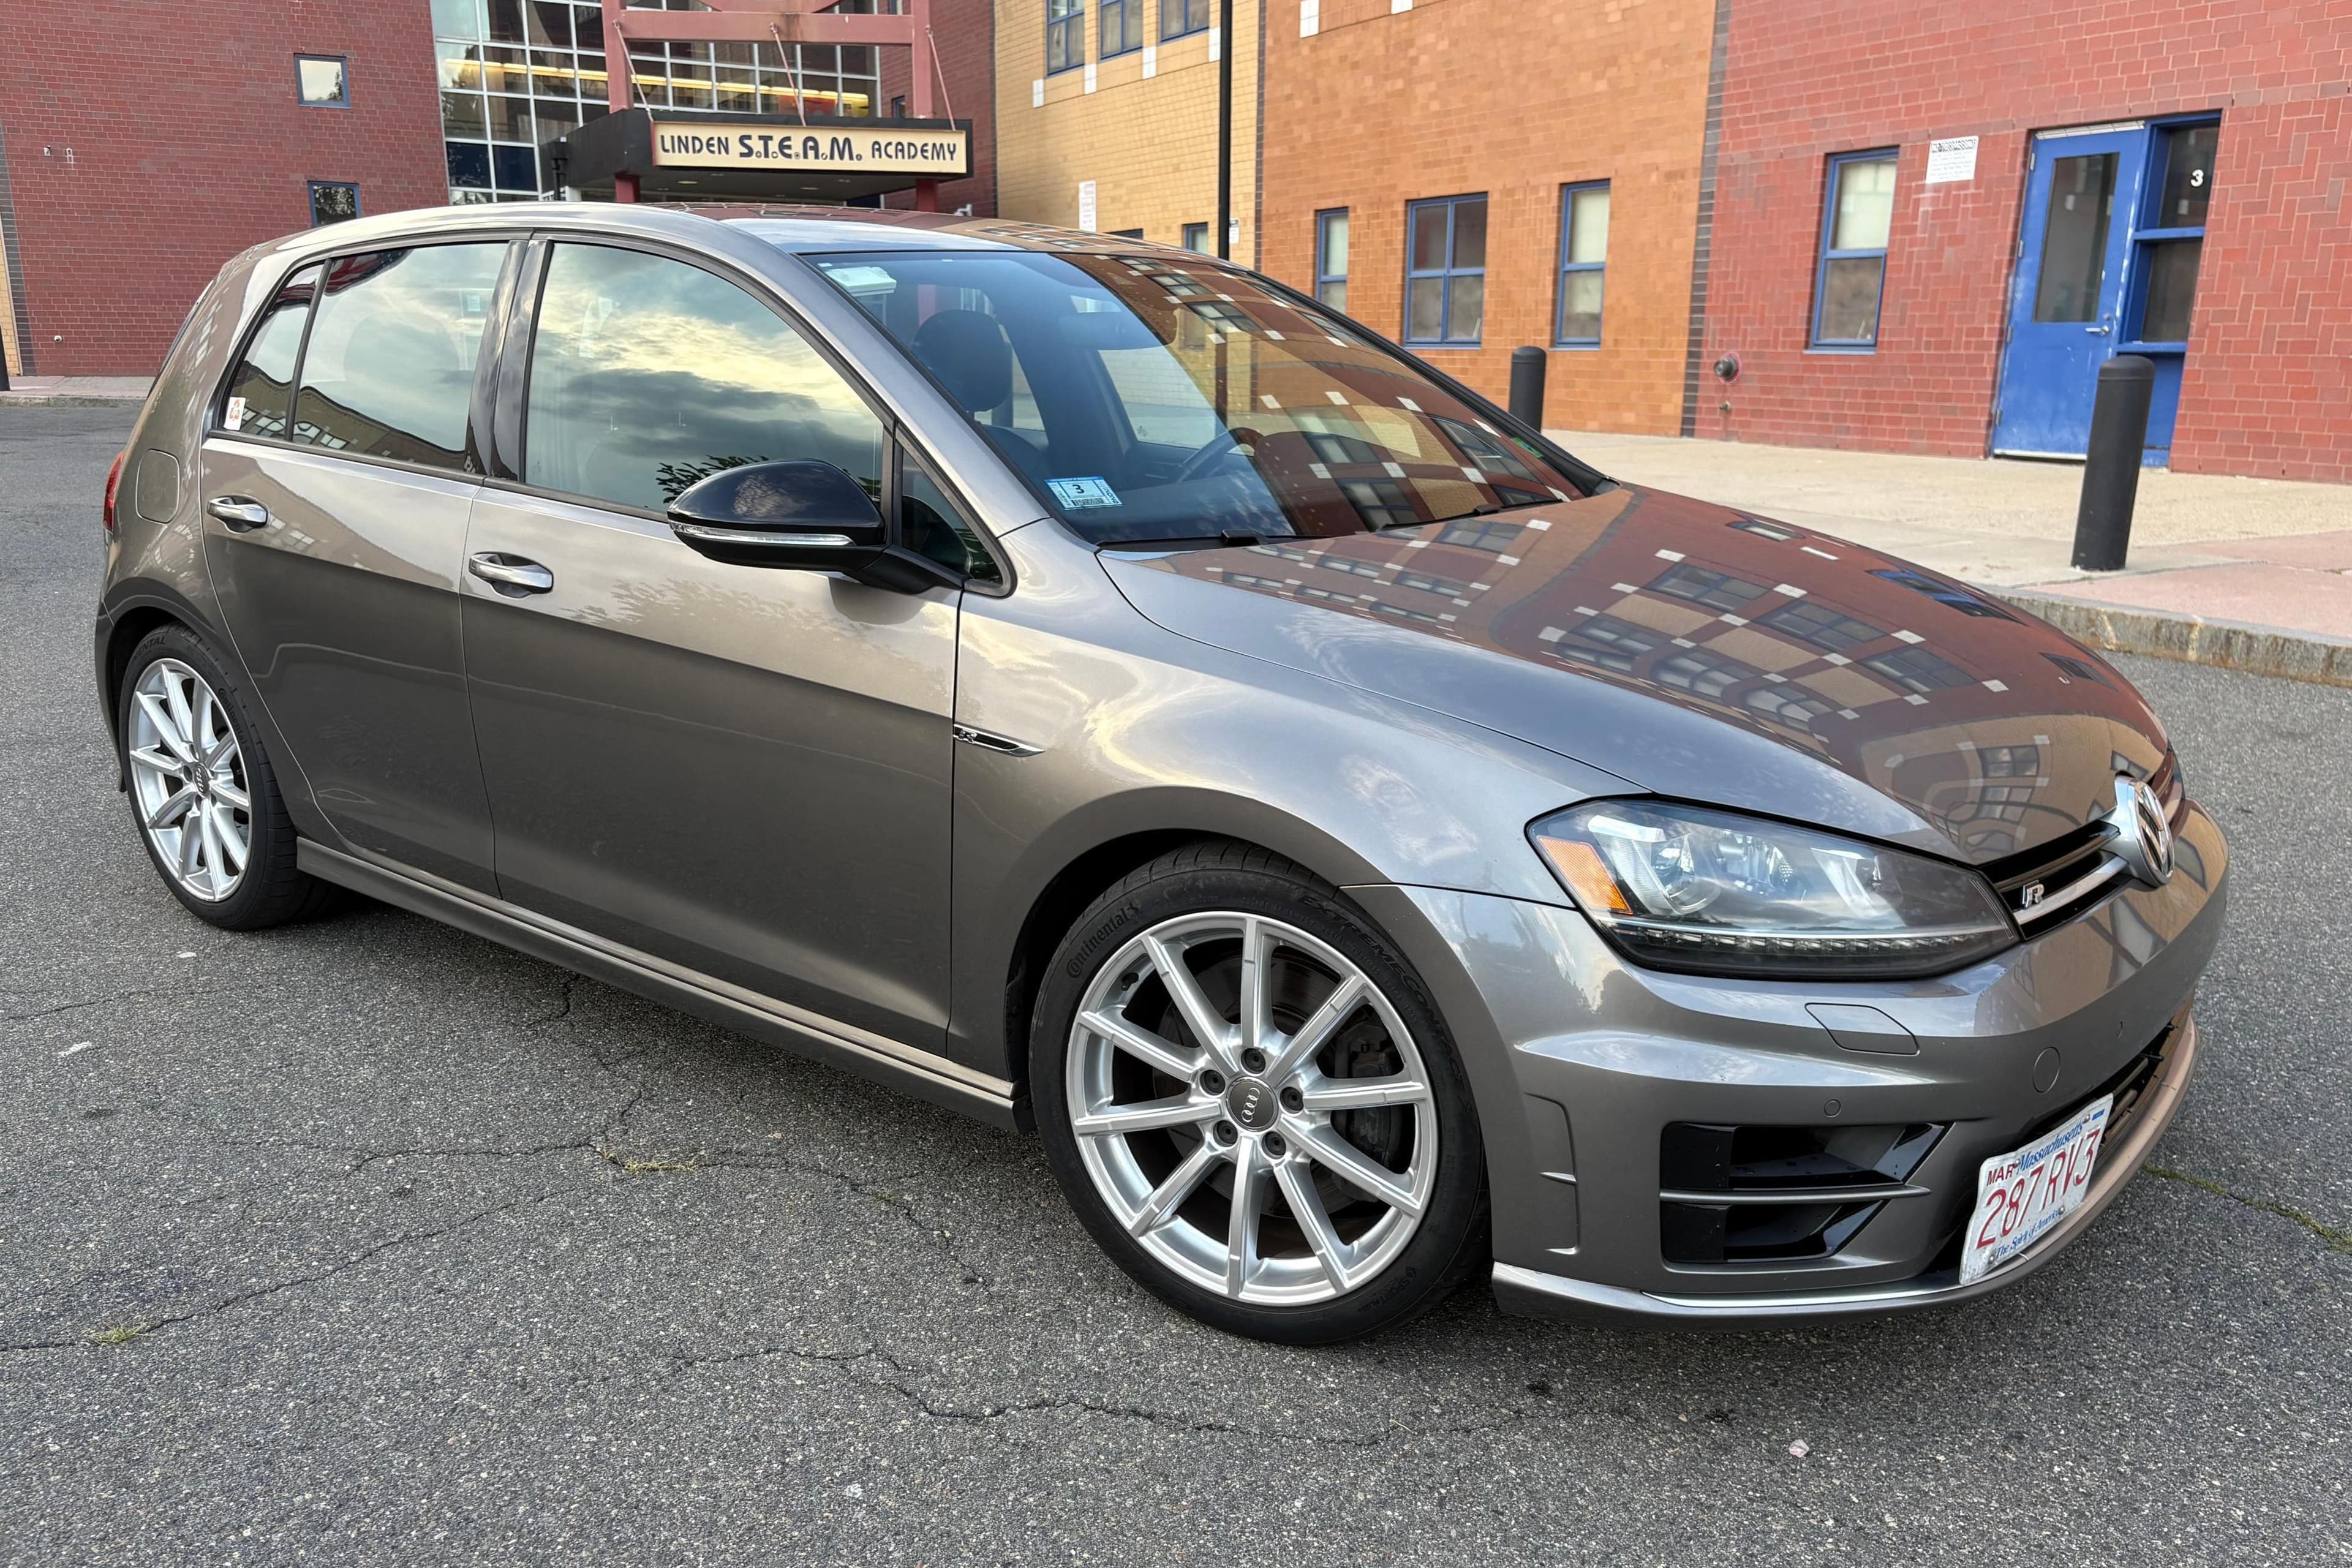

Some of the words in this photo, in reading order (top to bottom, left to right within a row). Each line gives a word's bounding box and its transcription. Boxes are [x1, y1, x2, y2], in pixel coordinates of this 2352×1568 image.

[660, 134, 730, 156] LINDEN
[739, 134, 862, 161] S.T.E.A.M.
[872, 141, 957, 161] ACADEMY
[2190, 169, 2204, 187] 3
[1072, 484, 1085, 494] 3
[2022, 880, 2045, 908] R
[1066, 909, 1129, 979] Continental
[1987, 1163, 2017, 1186] MAR
[2016, 1121, 2083, 1175] Massachusetts
[1977, 1163, 2045, 1248] 287
[2041, 1128, 2101, 1210] RV3
[1996, 1244, 2010, 1258] The
[2010, 1232, 2028, 1250] Spirit
